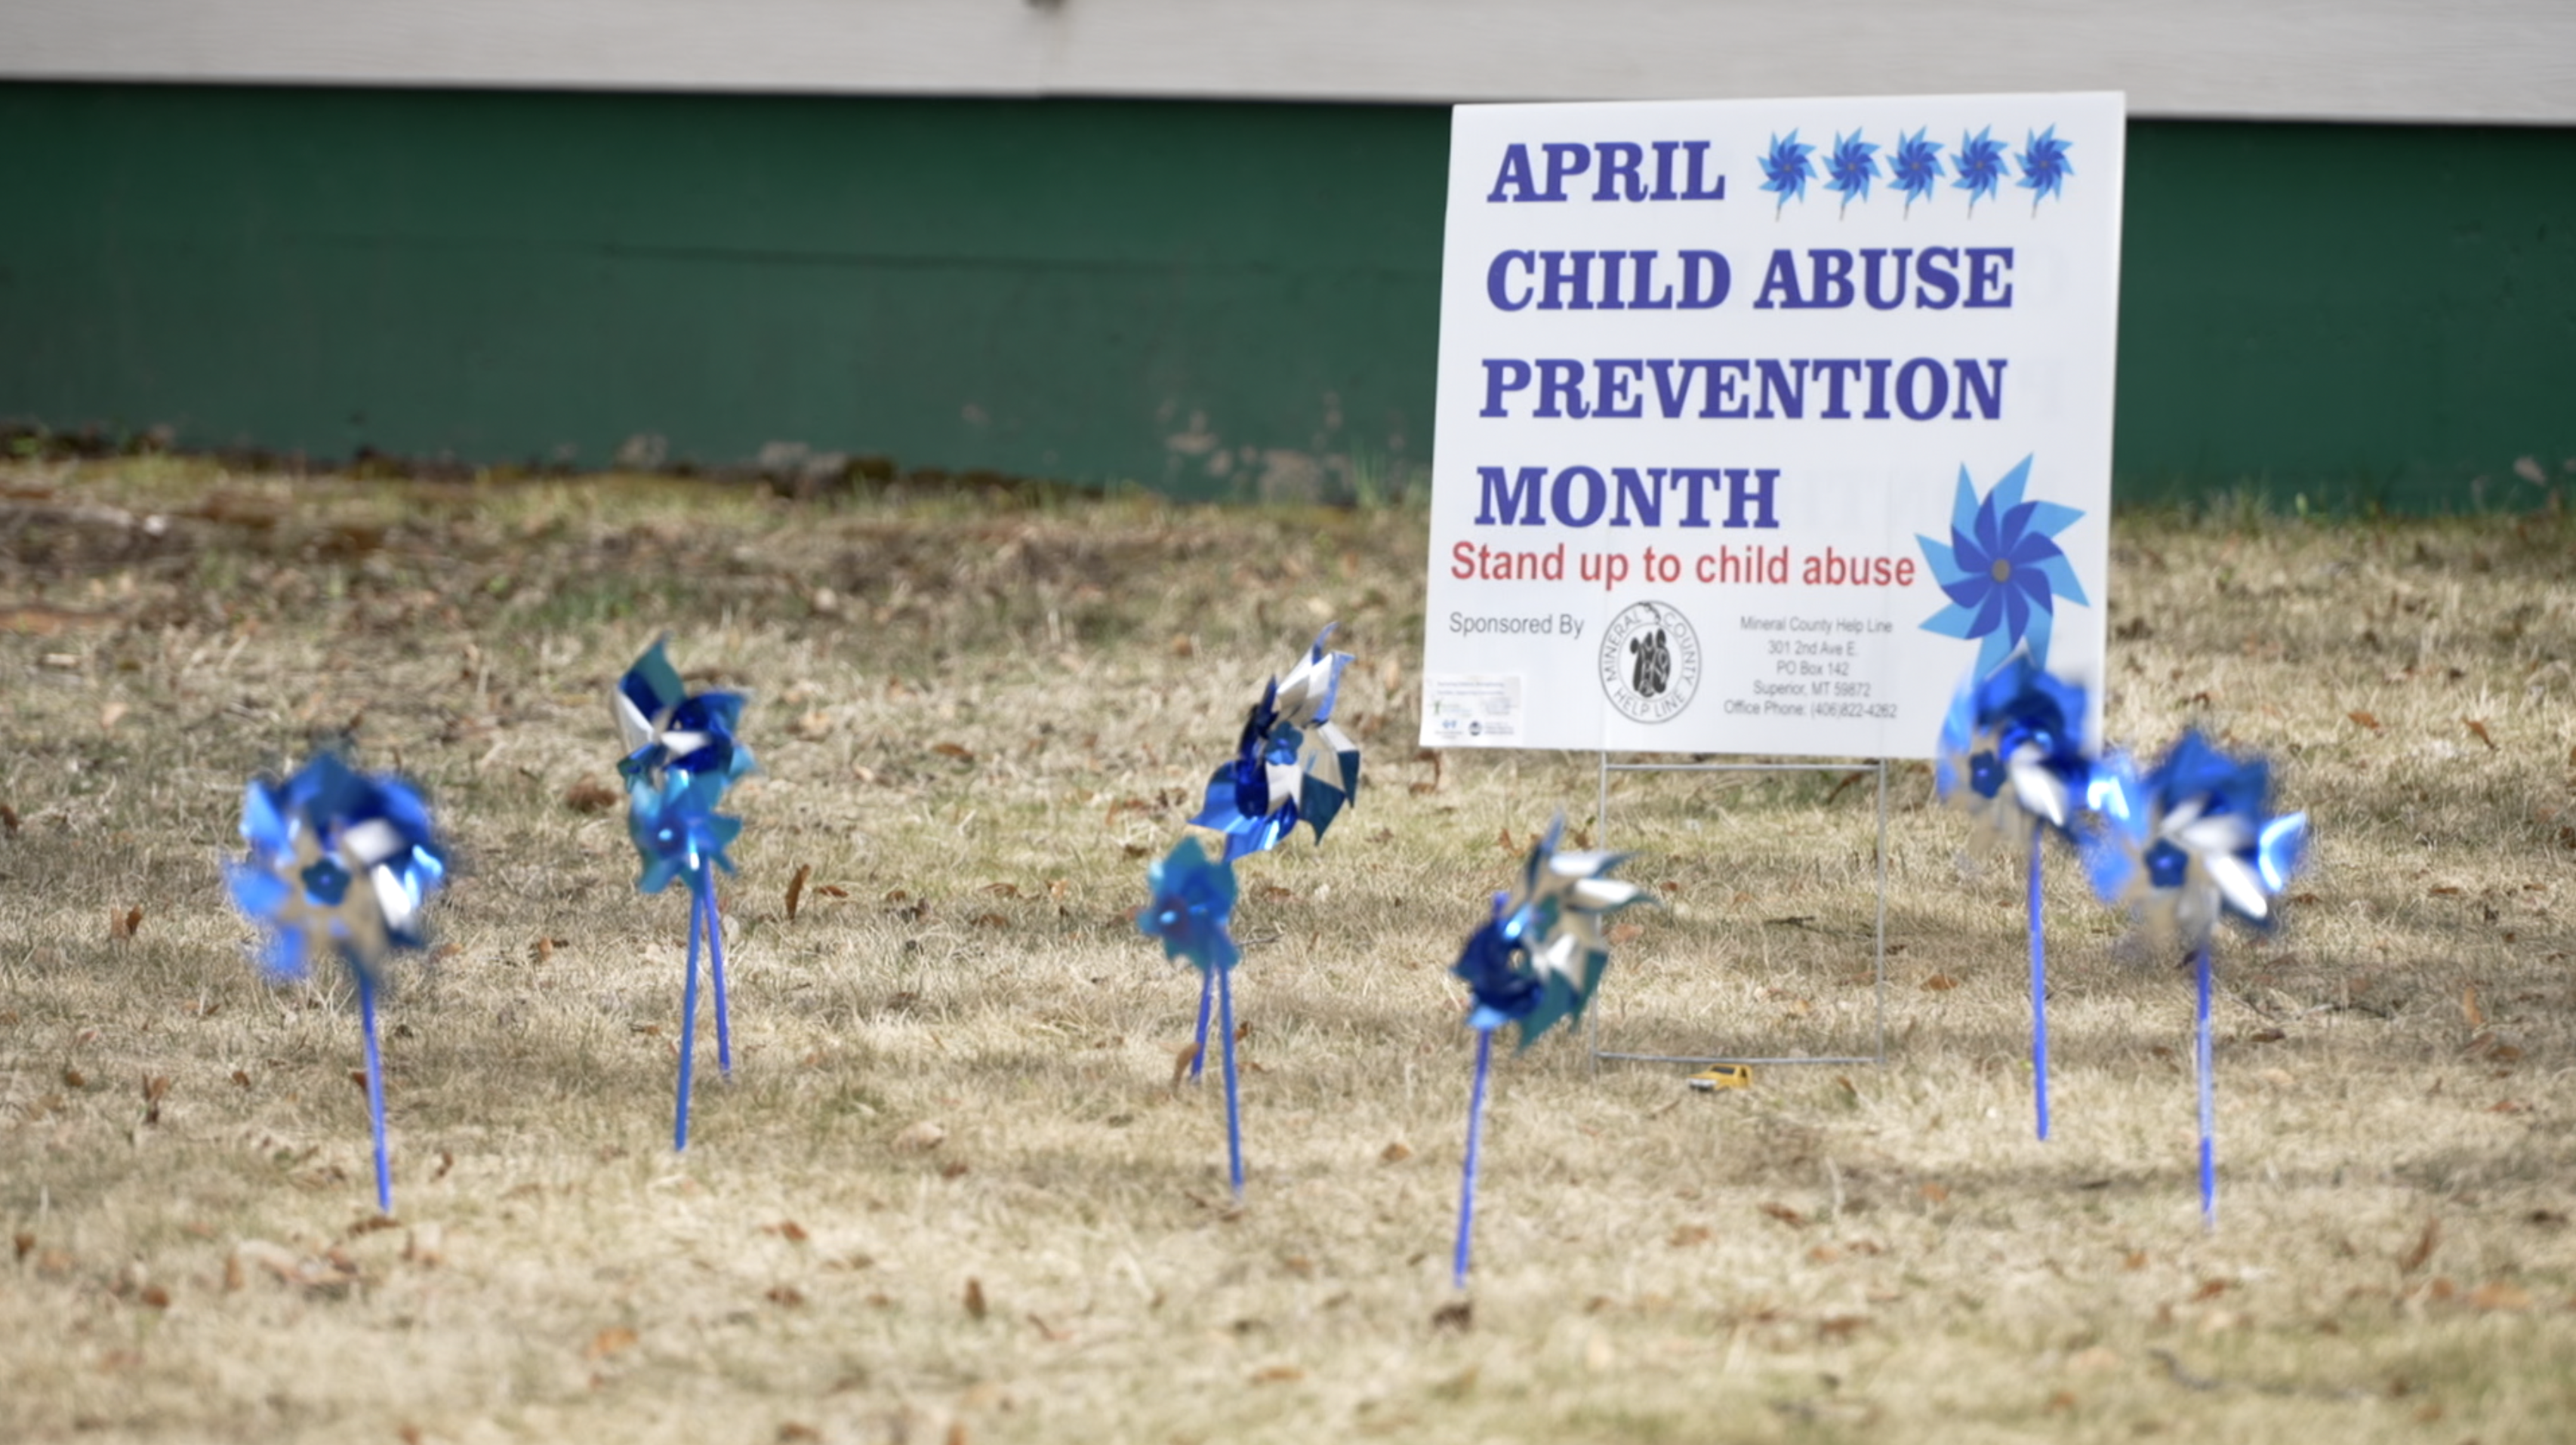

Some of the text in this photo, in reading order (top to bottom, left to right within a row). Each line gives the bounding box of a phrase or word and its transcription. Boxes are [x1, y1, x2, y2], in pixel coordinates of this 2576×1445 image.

[1487, 140, 1725, 202] APRIL
[1487, 246, 2014, 311] CHILD ABUSE
[1479, 357, 2008, 421] PREVENTION
[1474, 465, 1781, 528] MONTH
[1450, 541, 1915, 591] Stand up to child abuse
[1450, 612, 1584, 639] Sponsored By
[1740, 616, 1893, 636] Mineral County Help Line
[1603, 609, 1697, 687] MINERAL COUNTY
[1768, 640, 1858, 656] 301 2nd Ave E.
[1776, 661, 1850, 676] PO Box 142
[1614, 687, 1686, 718] HELP LINE
[1753, 680, 1871, 698] Superior, MT 59872
[1724, 700, 1761, 715] Office
[1764, 700, 1805, 716] Phone:
